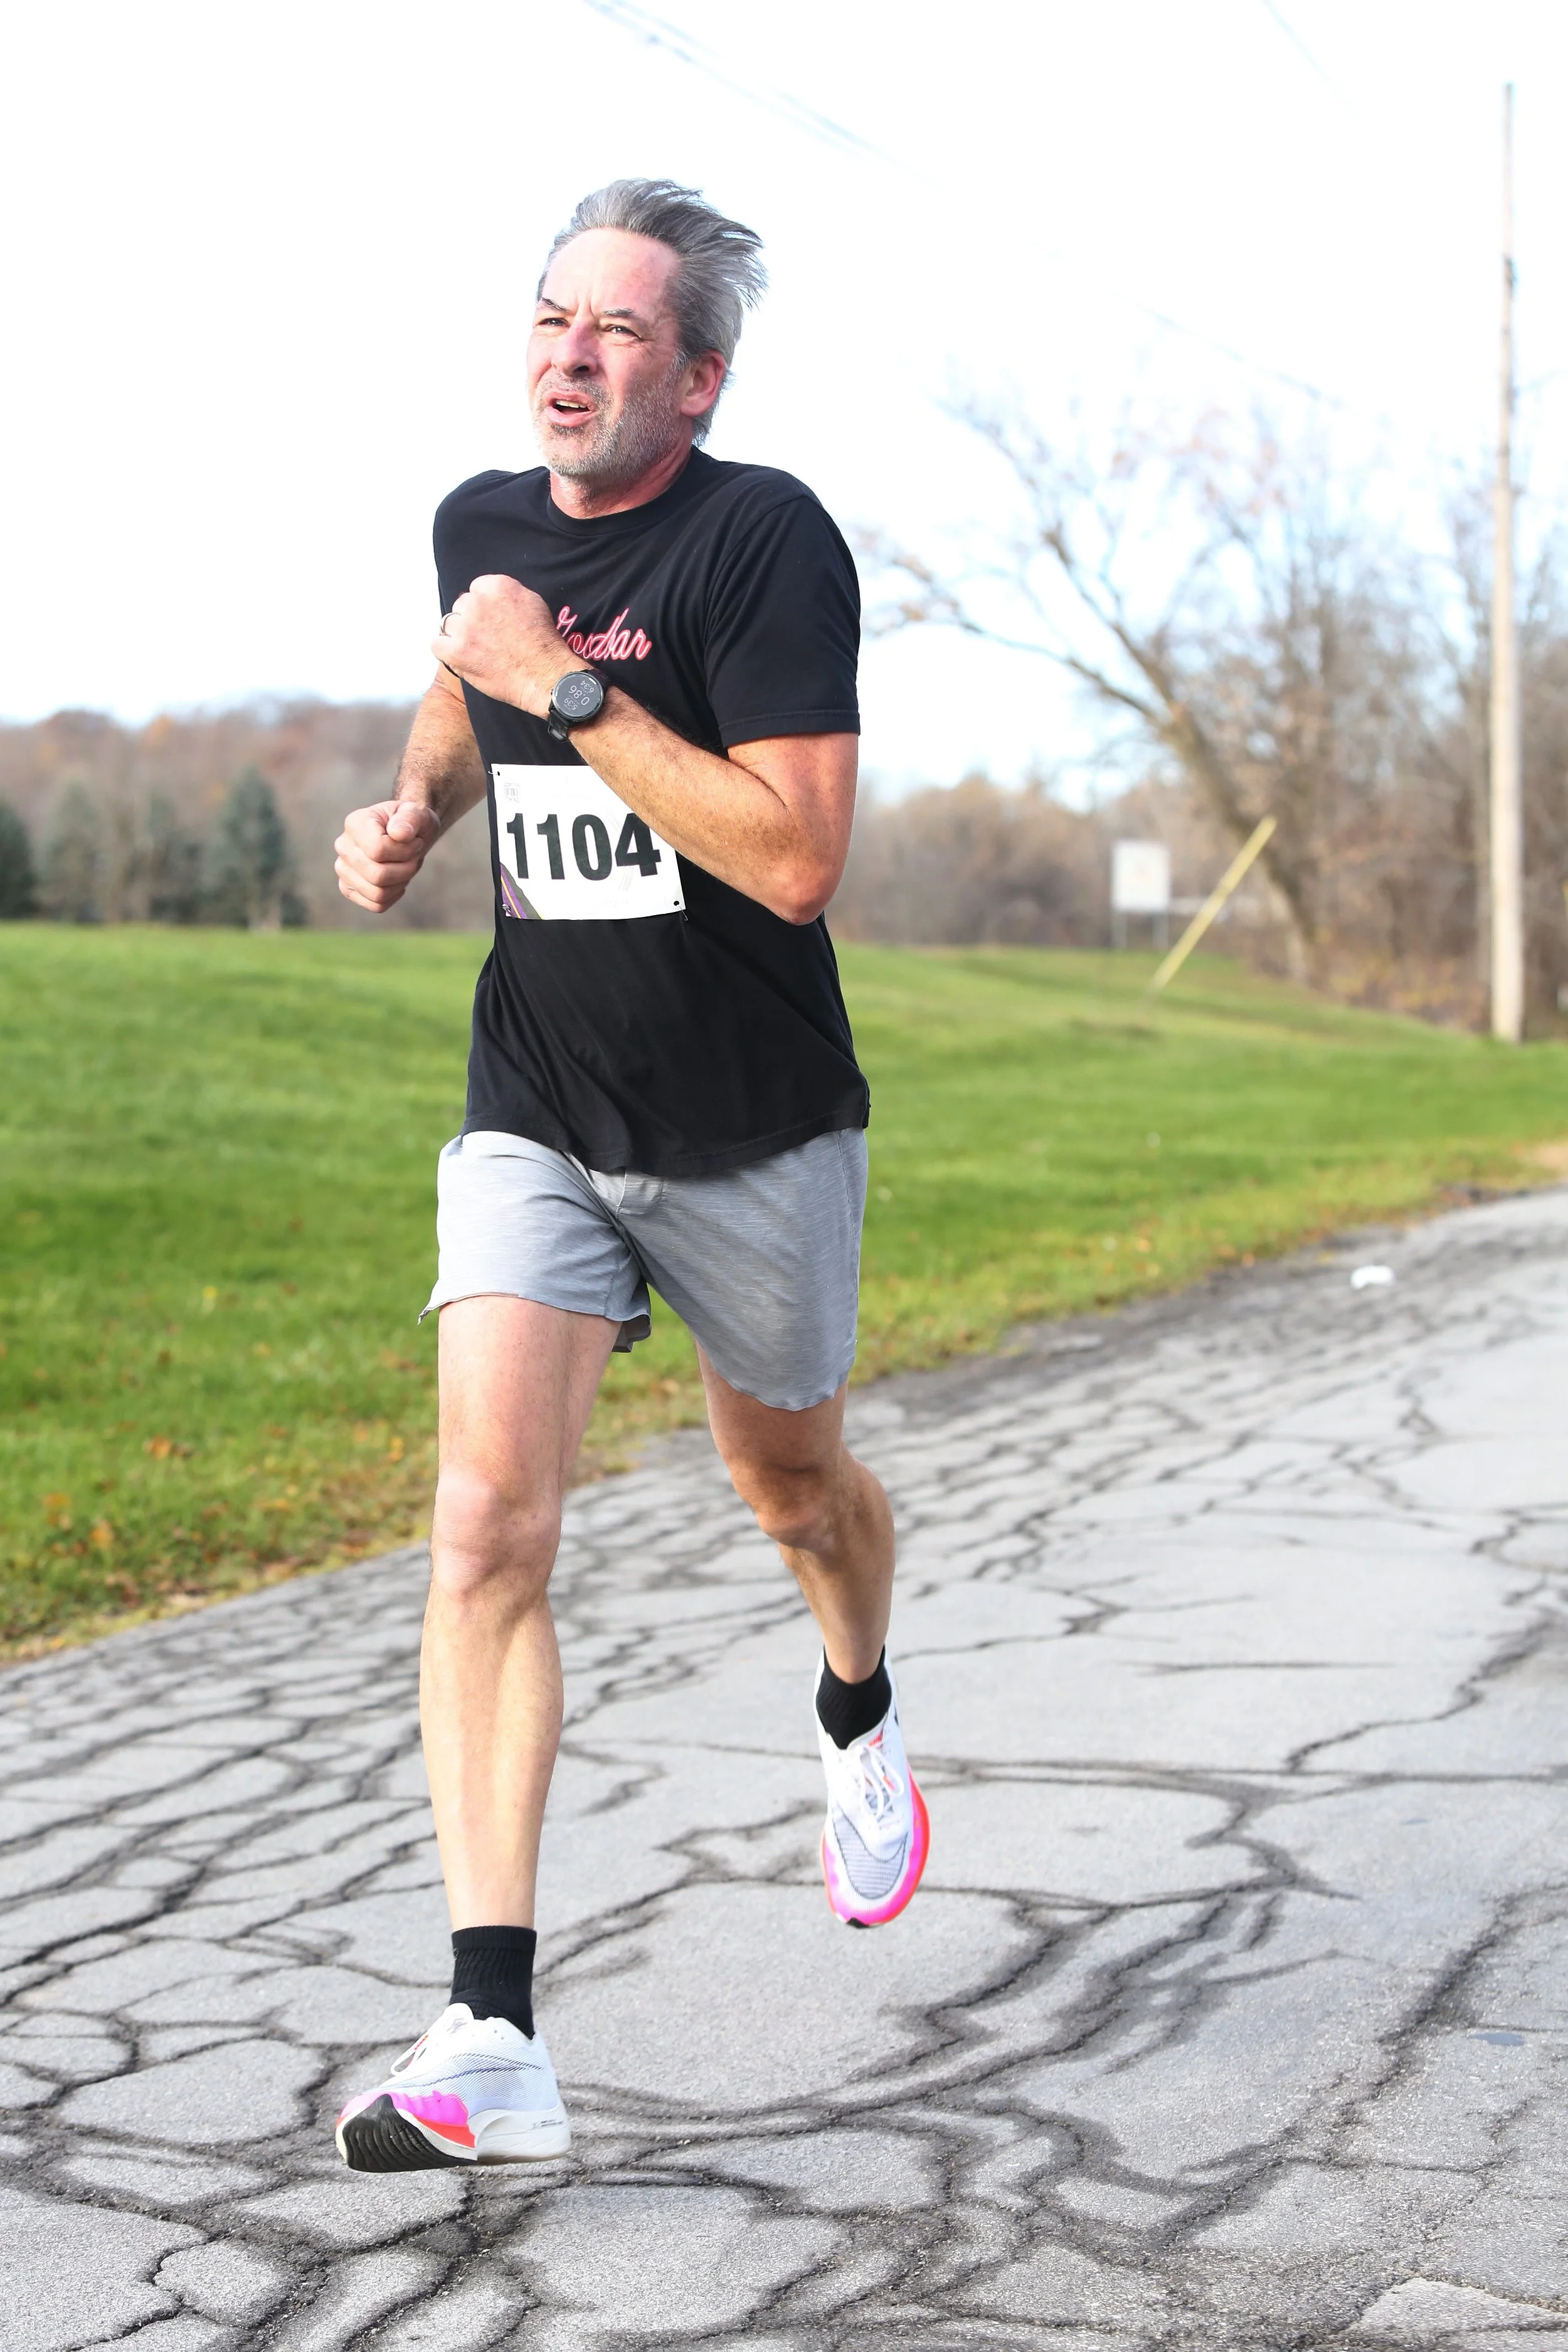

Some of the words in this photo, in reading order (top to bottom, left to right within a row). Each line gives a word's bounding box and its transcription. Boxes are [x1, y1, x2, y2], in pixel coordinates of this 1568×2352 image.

[568, 685, 590, 706] 0.86
[580, 681, 595, 693] 6:34
[564, 697, 578, 711] 5:39
[506, 813, 662, 881] 1104
